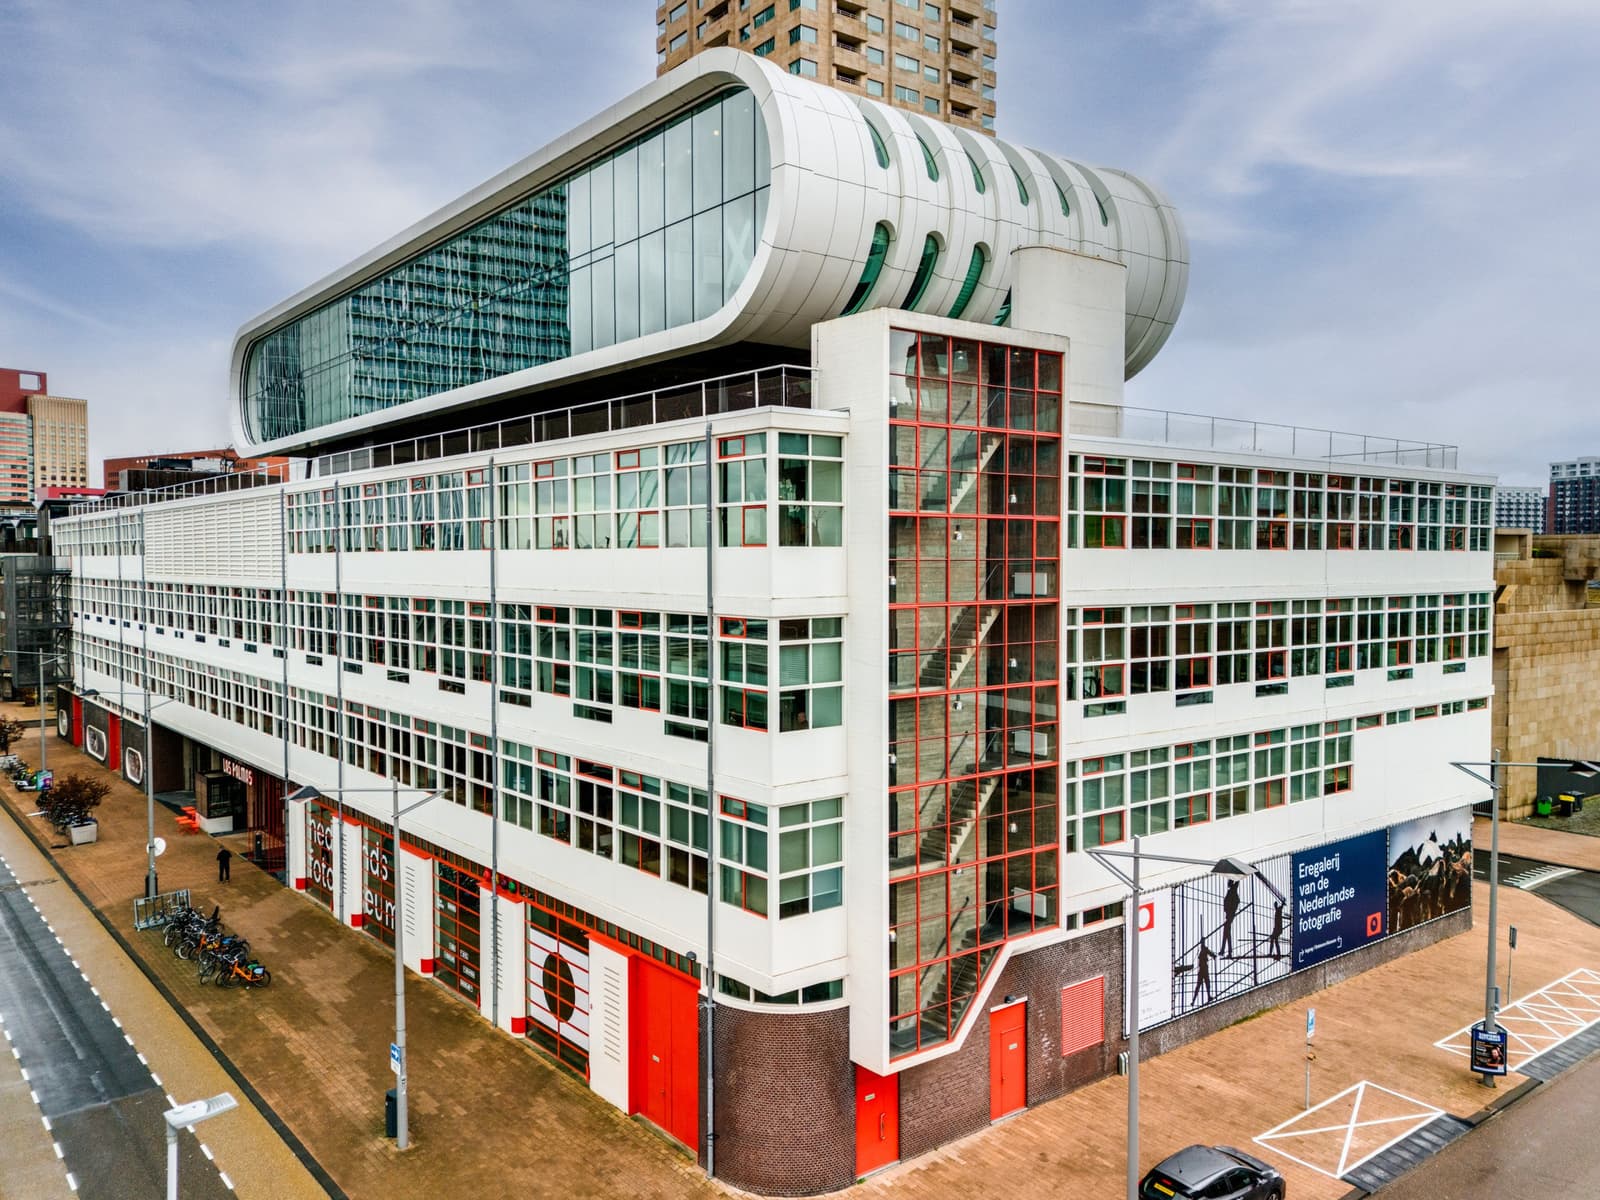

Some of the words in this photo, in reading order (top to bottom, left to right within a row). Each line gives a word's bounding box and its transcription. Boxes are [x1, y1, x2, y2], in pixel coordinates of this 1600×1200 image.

[310, 848, 333, 892] oto
[1298, 853, 1340, 879] Eregalerij
[1299, 881, 1316, 897] van
[1317, 875, 1329, 891] de
[1299, 886, 1355, 915] Nederlandse
[1299, 907, 1342, 933] fotografie
